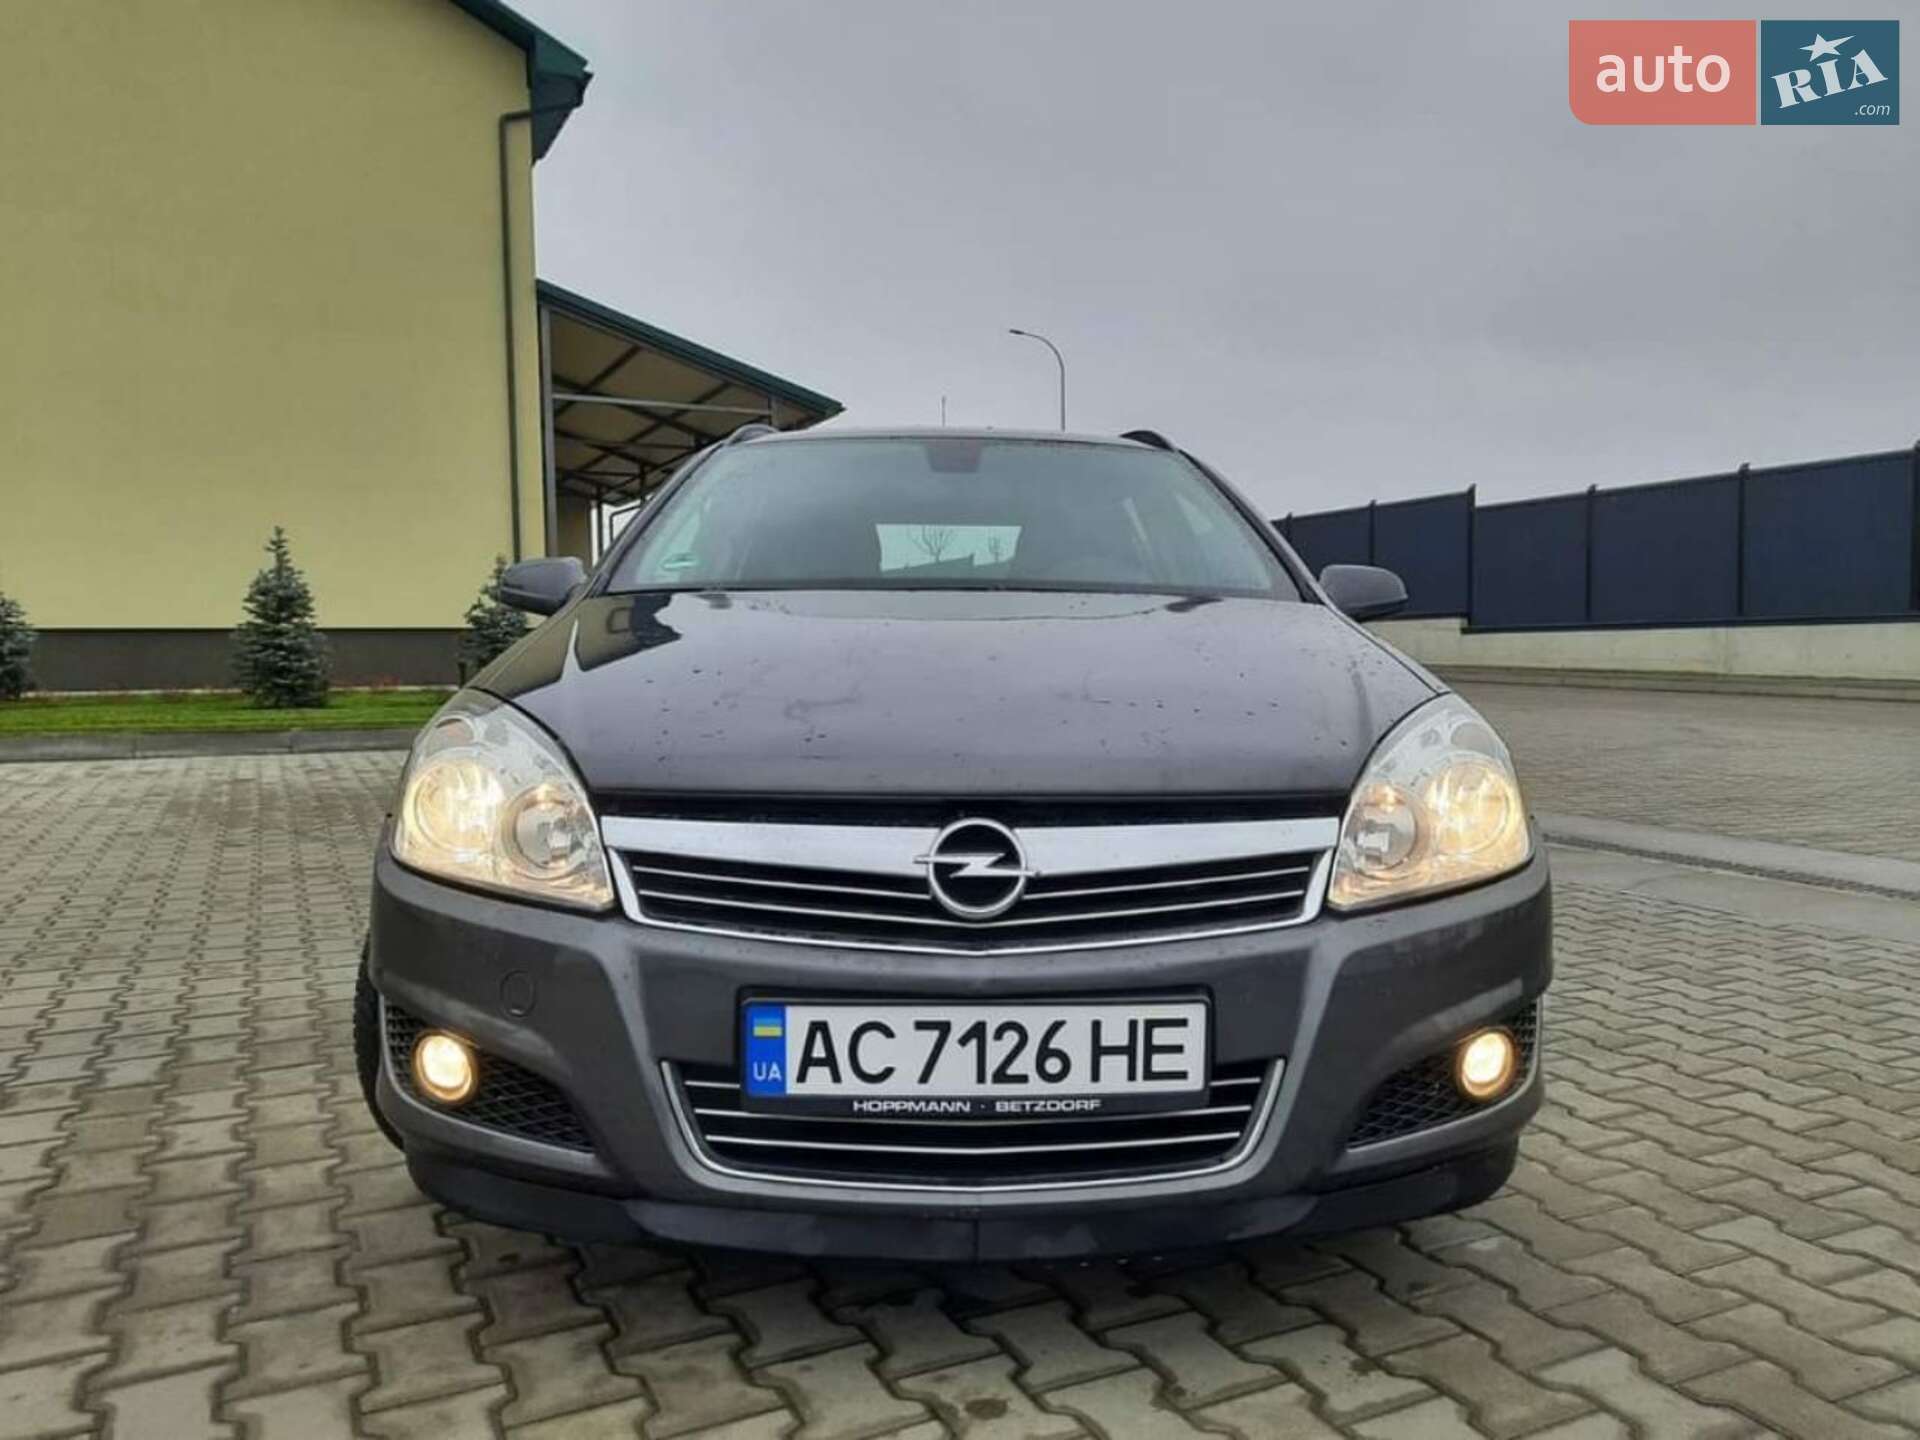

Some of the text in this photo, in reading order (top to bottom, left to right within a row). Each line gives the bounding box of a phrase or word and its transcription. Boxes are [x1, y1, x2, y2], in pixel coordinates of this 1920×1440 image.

[796, 1018, 1189, 1084] AC 7126 HE
[753, 1061, 782, 1082] UA
[853, 1099, 1102, 1113] HOPPMANN BETZDORF
